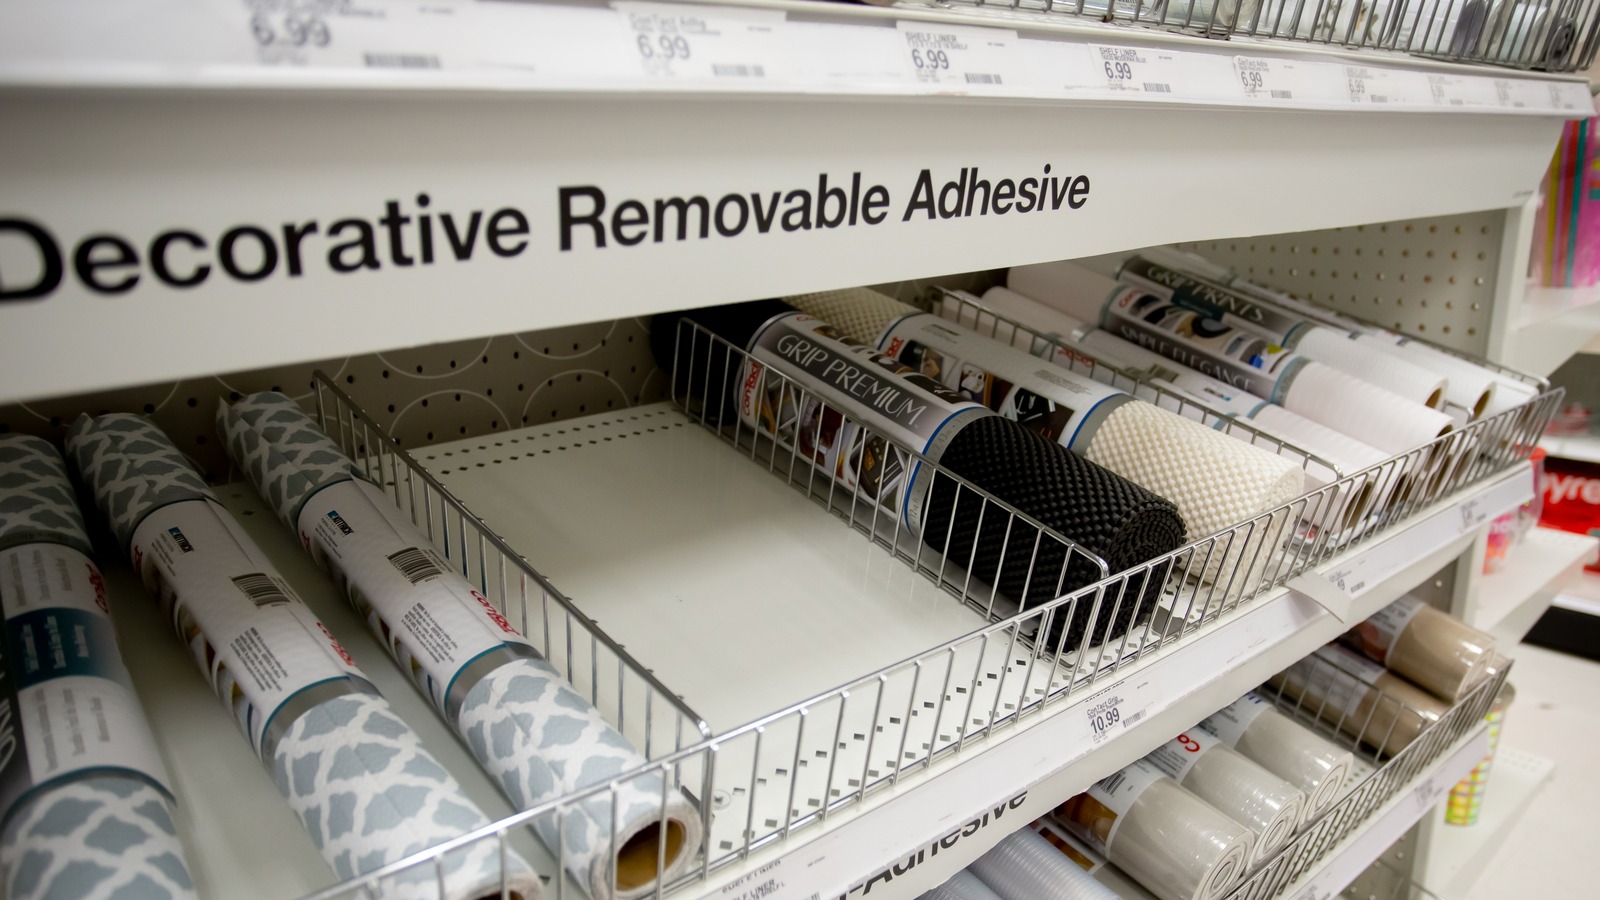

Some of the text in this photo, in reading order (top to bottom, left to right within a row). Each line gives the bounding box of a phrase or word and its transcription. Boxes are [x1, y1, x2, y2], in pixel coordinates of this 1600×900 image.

[250, 14, 332, 47] 6.99
[905, 32, 958, 42] SHELF LINER
[637, 34, 691, 60] 6.99
[1099, 47, 1119, 56] SHELF
[1120, 49, 1137, 57] LINER
[911, 48, 950, 70] 6.99
[1104, 61, 1133, 80] 6.99
[1240, 71, 1263, 88] 6.99
[1348, 78, 1366, 94] 6.99
[0, 163, 1091, 302] Decorative Removable Adhesive
[776, 334, 928, 426] GRIP PREMIUM
[1107, 696, 1119, 706] Grip
[1090, 707, 1120, 734] 10.99
